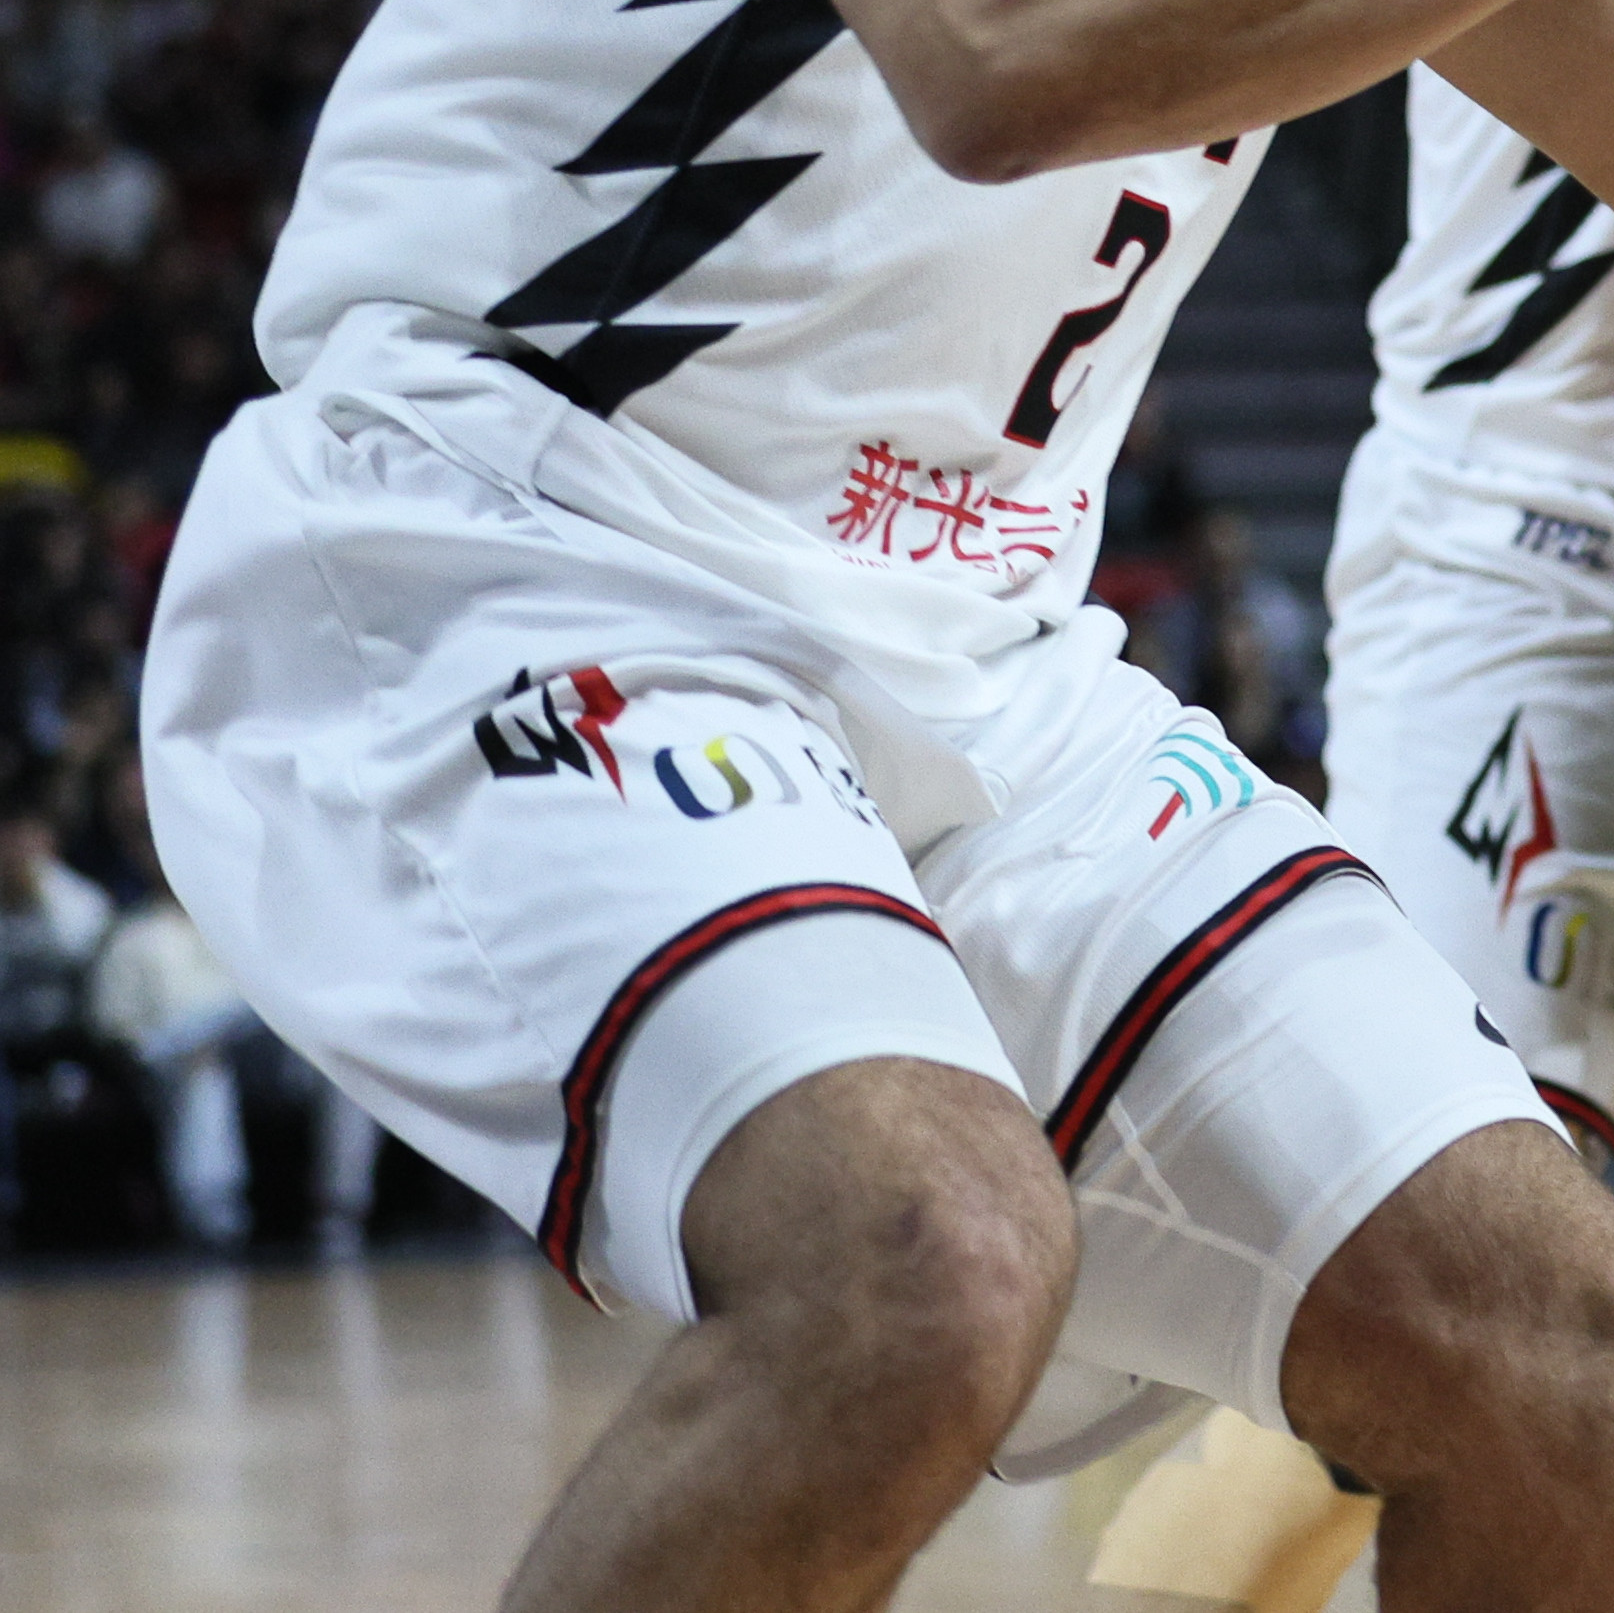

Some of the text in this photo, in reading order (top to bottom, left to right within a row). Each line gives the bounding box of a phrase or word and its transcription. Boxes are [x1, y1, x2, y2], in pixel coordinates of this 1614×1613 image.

[1003, 189, 1171, 449] 2
[826, 440, 1090, 564] 新光三
